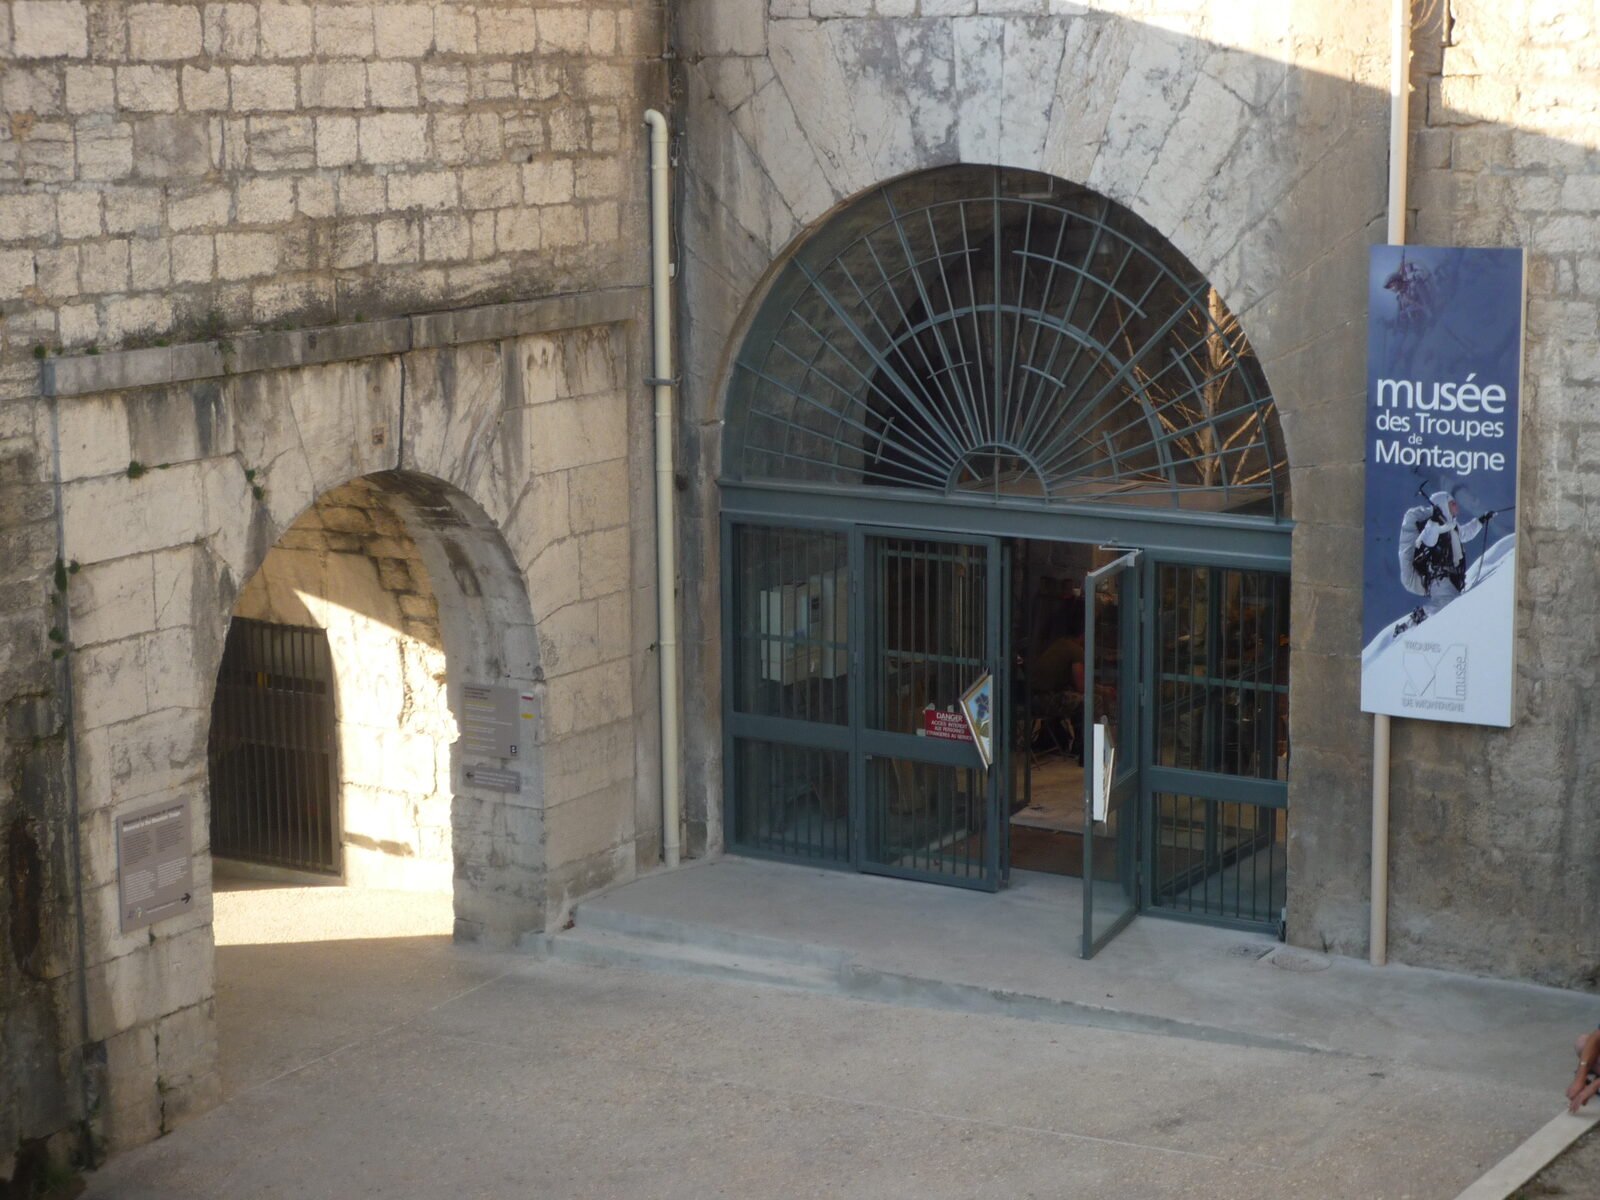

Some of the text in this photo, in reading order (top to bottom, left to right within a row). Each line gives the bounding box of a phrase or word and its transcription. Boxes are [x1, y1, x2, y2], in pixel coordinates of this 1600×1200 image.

[1377, 373, 1506, 413] musée
[1376, 409, 1504, 442] des Troupes
[1408, 433, 1423, 445] de
[1375, 439, 1505, 476] Montagne
[936, 712, 963, 721] DANGER
